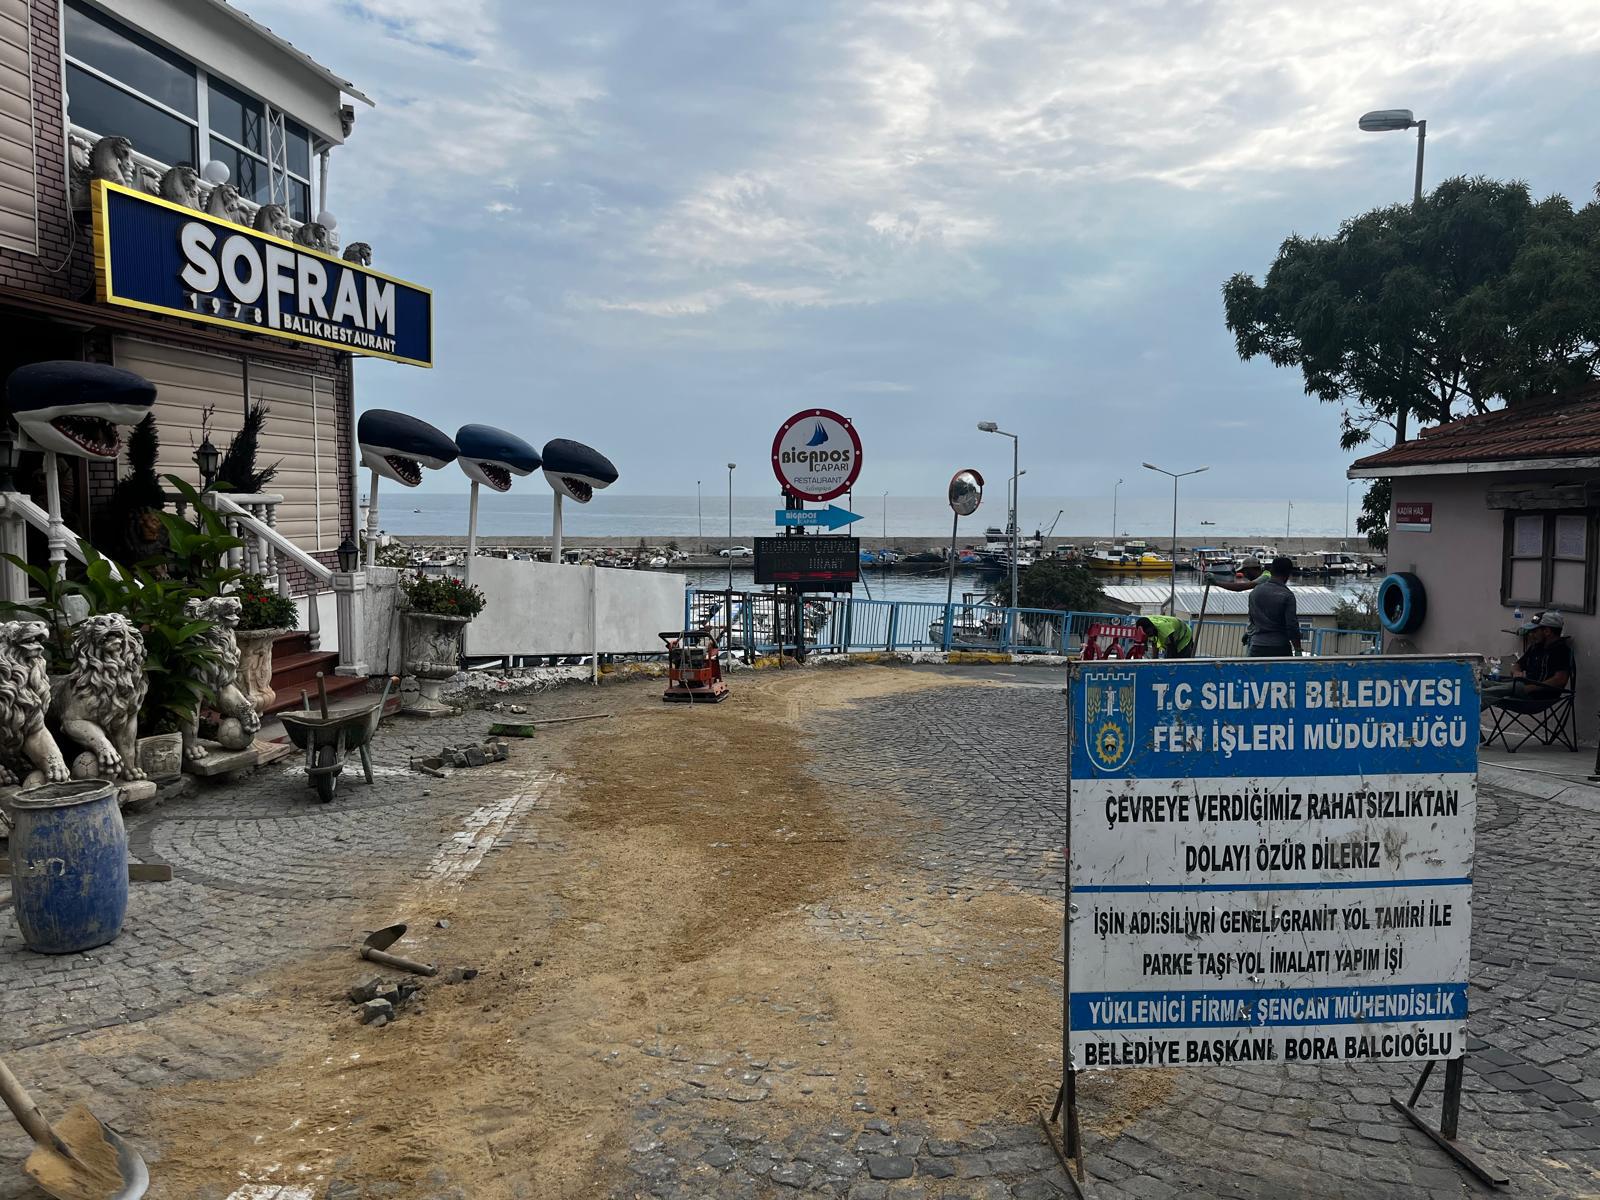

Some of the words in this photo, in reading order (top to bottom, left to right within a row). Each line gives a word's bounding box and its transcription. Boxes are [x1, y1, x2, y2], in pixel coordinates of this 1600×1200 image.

[181, 221, 396, 336] SOFRAM
[782, 446, 850, 472] BİGADOS
[1154, 725, 1203, 753] FEN
[1212, 718, 1295, 759] İŞLERİ
[1304, 715, 1467, 750] MÜDÜRLÜĞÜ
[1105, 794, 1190, 830] ÇEVREYE
[1195, 787, 1302, 823] VERDİĞİMİZ
[1307, 789, 1459, 820] RAHATSIZLIKTAN
[1185, 845, 1251, 872] DOLAYI
[1256, 838, 1307, 871] ÖZÜR
[1312, 836, 1381, 870] DİLERİZ
[1094, 906, 1125, 940] İŞİN
[1280, 903, 1338, 932] GRANİT
[1342, 908, 1371, 931] YOL
[1374, 899, 1425, 929] TAMİRİ
[1429, 898, 1452, 927] İLE
[1142, 952, 1193, 976] PARKE
[1197, 951, 1231, 980] TAŞI
[1236, 951, 1266, 975] YOL
[1269, 946, 1330, 974] İMALATI
[1335, 948, 1380, 972] YAPIM
[1384, 942, 1403, 976] İŞİ
[1088, 994, 1186, 1025] YÜKLENİCİ
[1257, 997, 1329, 1027] ŞENCAN
[1335, 987, 1455, 1019] MÜHENDİSLİK
[1084, 1035, 1180, 1066] BELEDİYE
[1285, 1037, 1339, 1061] BORA
[1344, 1028, 1452, 1060] BALCIOĞLU
